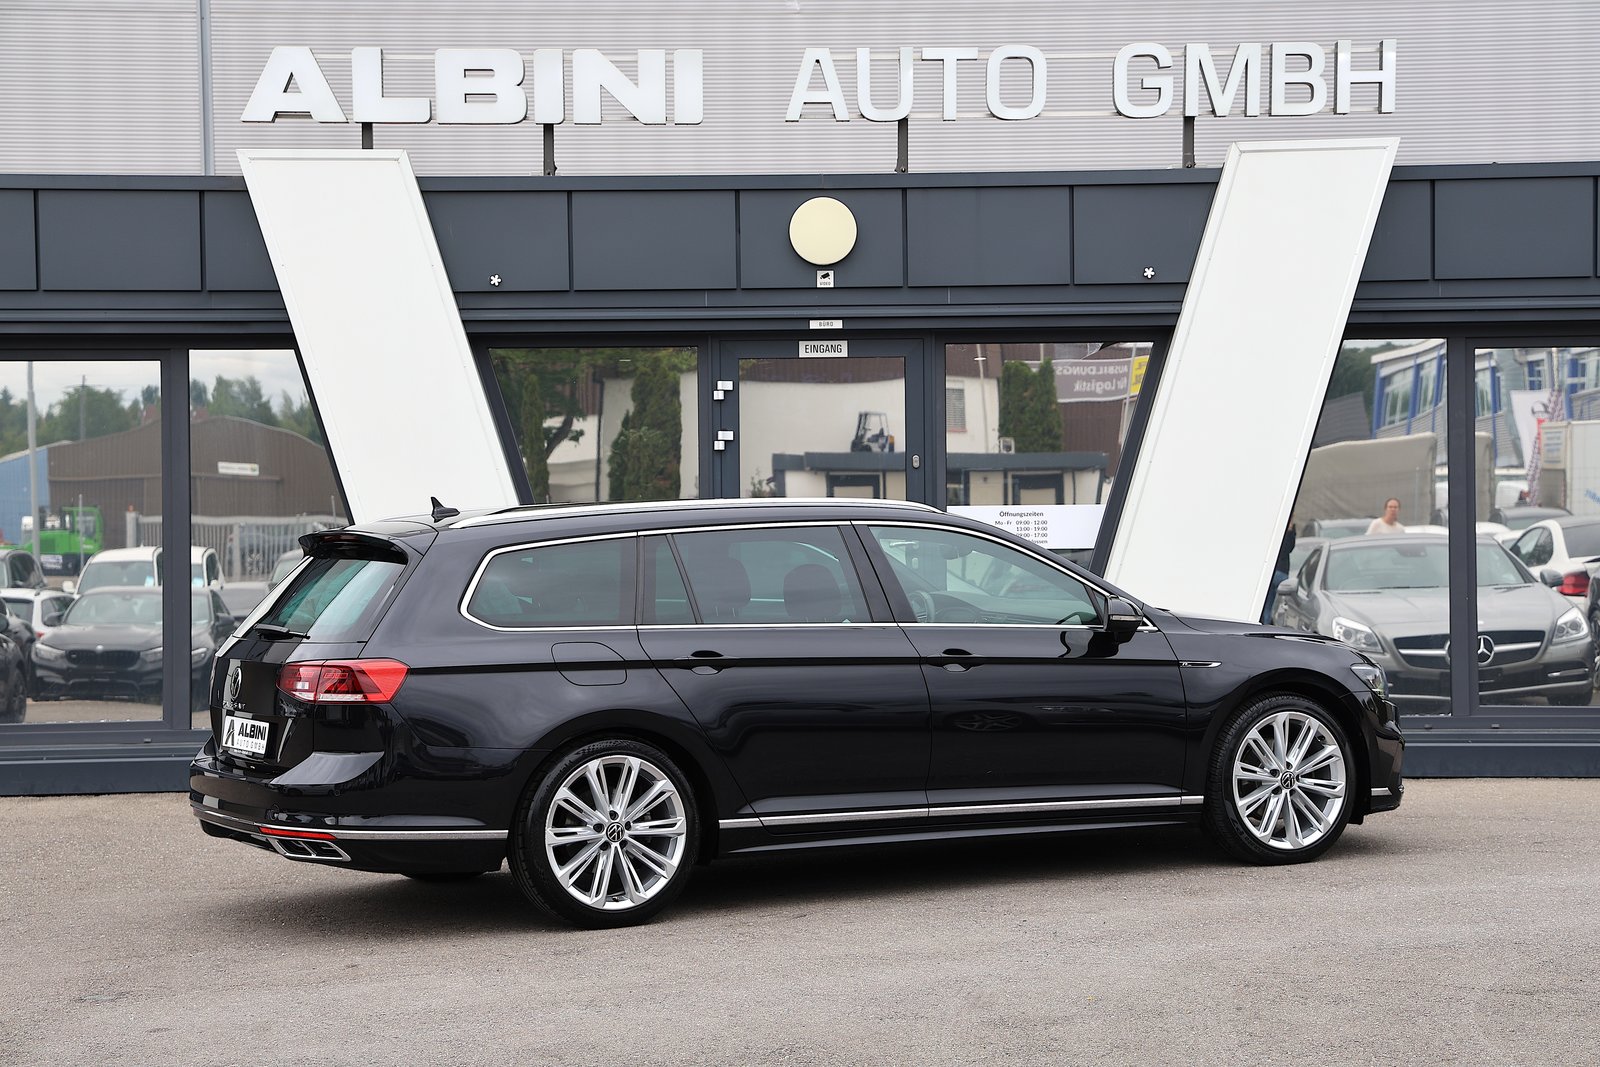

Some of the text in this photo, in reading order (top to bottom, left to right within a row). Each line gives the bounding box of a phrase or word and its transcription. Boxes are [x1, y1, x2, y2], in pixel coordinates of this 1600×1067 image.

[240, 38, 1398, 125] ALBINI AUTO GMBH
[804, 344, 842, 354] EINGANG
[238, 722, 267, 741] ALBINI
